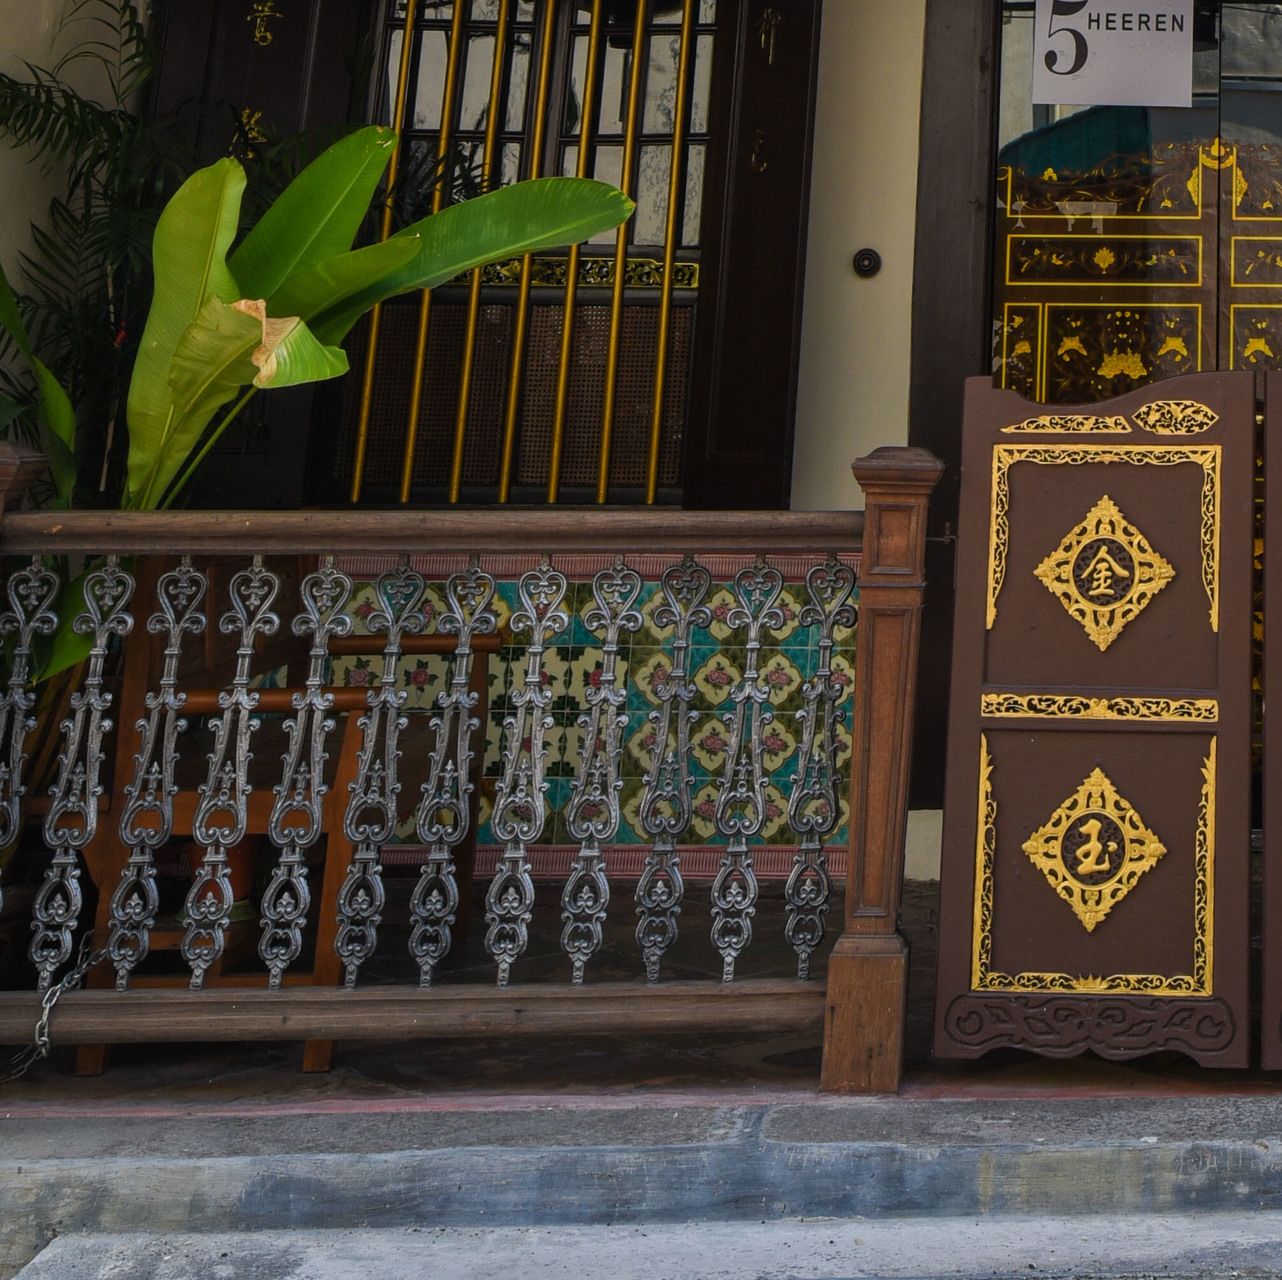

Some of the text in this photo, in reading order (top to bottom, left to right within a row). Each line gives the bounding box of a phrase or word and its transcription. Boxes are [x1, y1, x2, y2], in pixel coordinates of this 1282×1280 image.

[1088, 12, 1184, 32] HEEREN
[1080, 544, 1130, 597] 金
[1075, 818, 1119, 876] 玉
